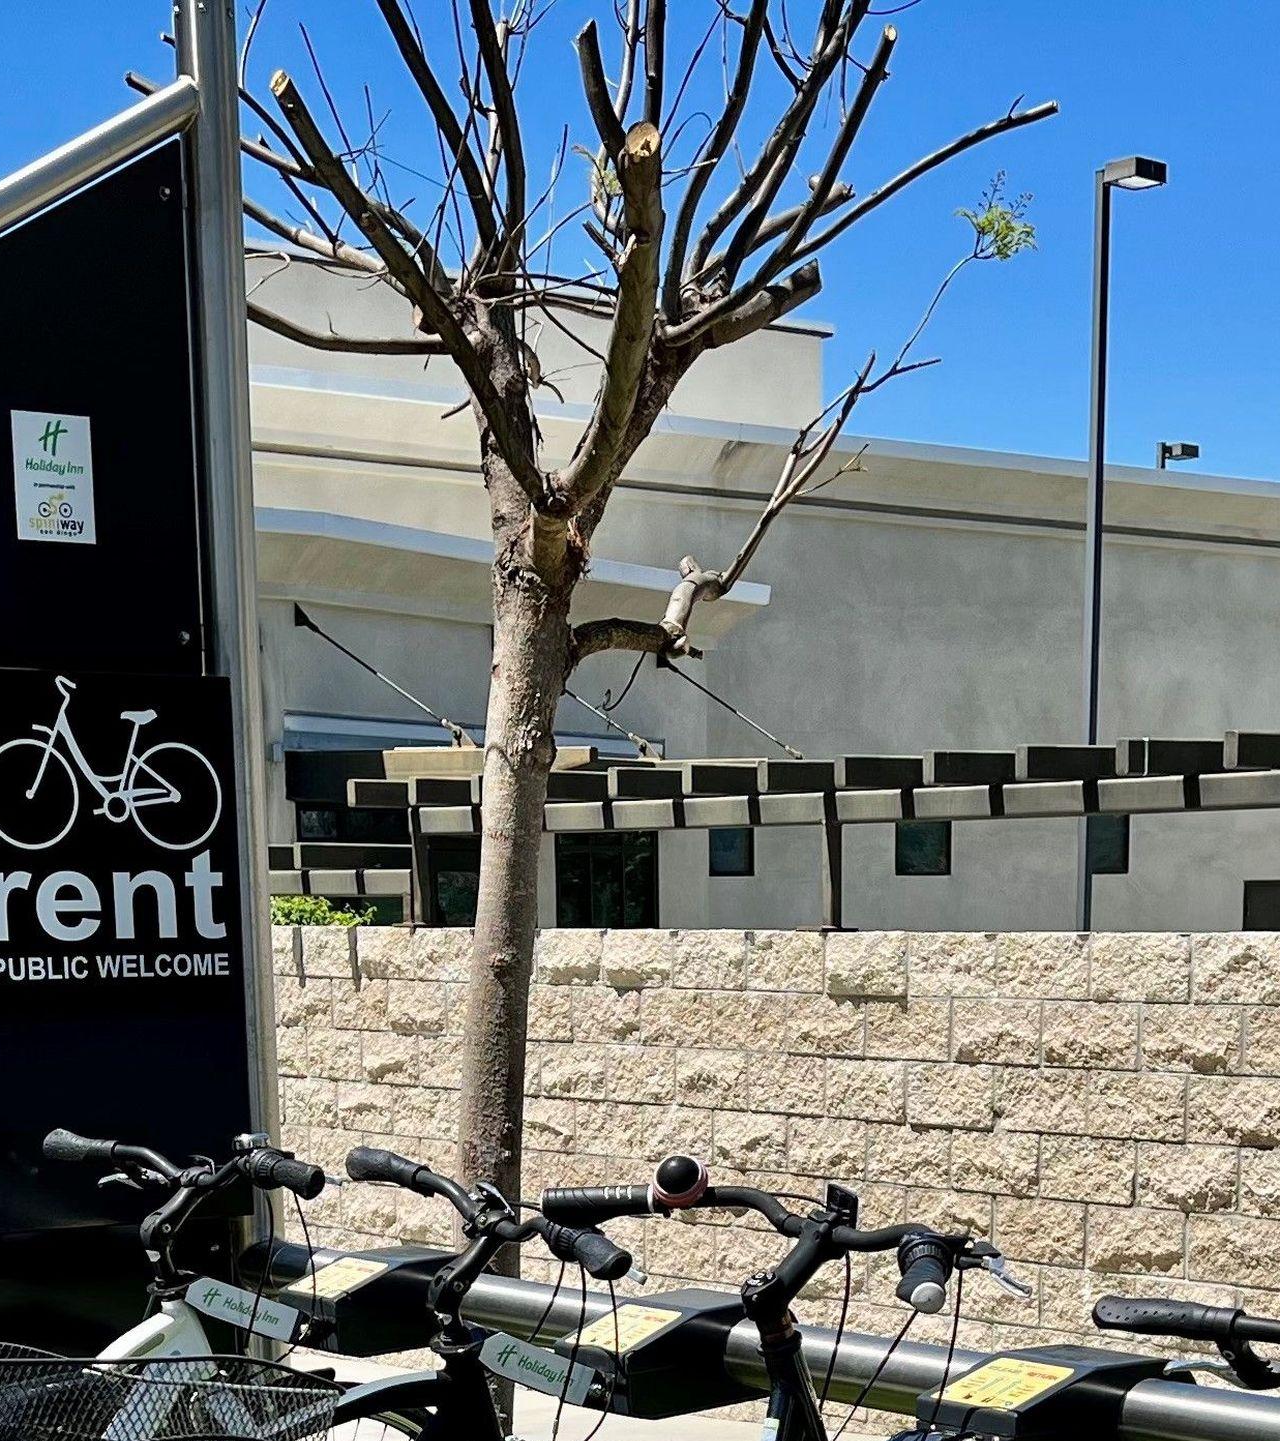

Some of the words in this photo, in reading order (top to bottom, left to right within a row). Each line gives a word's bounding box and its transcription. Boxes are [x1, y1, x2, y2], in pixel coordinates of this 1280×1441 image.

[25, 458, 67, 475] Holiday
[68, 461, 84, 475] Inn
[95, 953, 231, 979] WELCOME
[261, 1310, 280, 1326] Inn
[517, 1354, 558, 1382] Holiday
